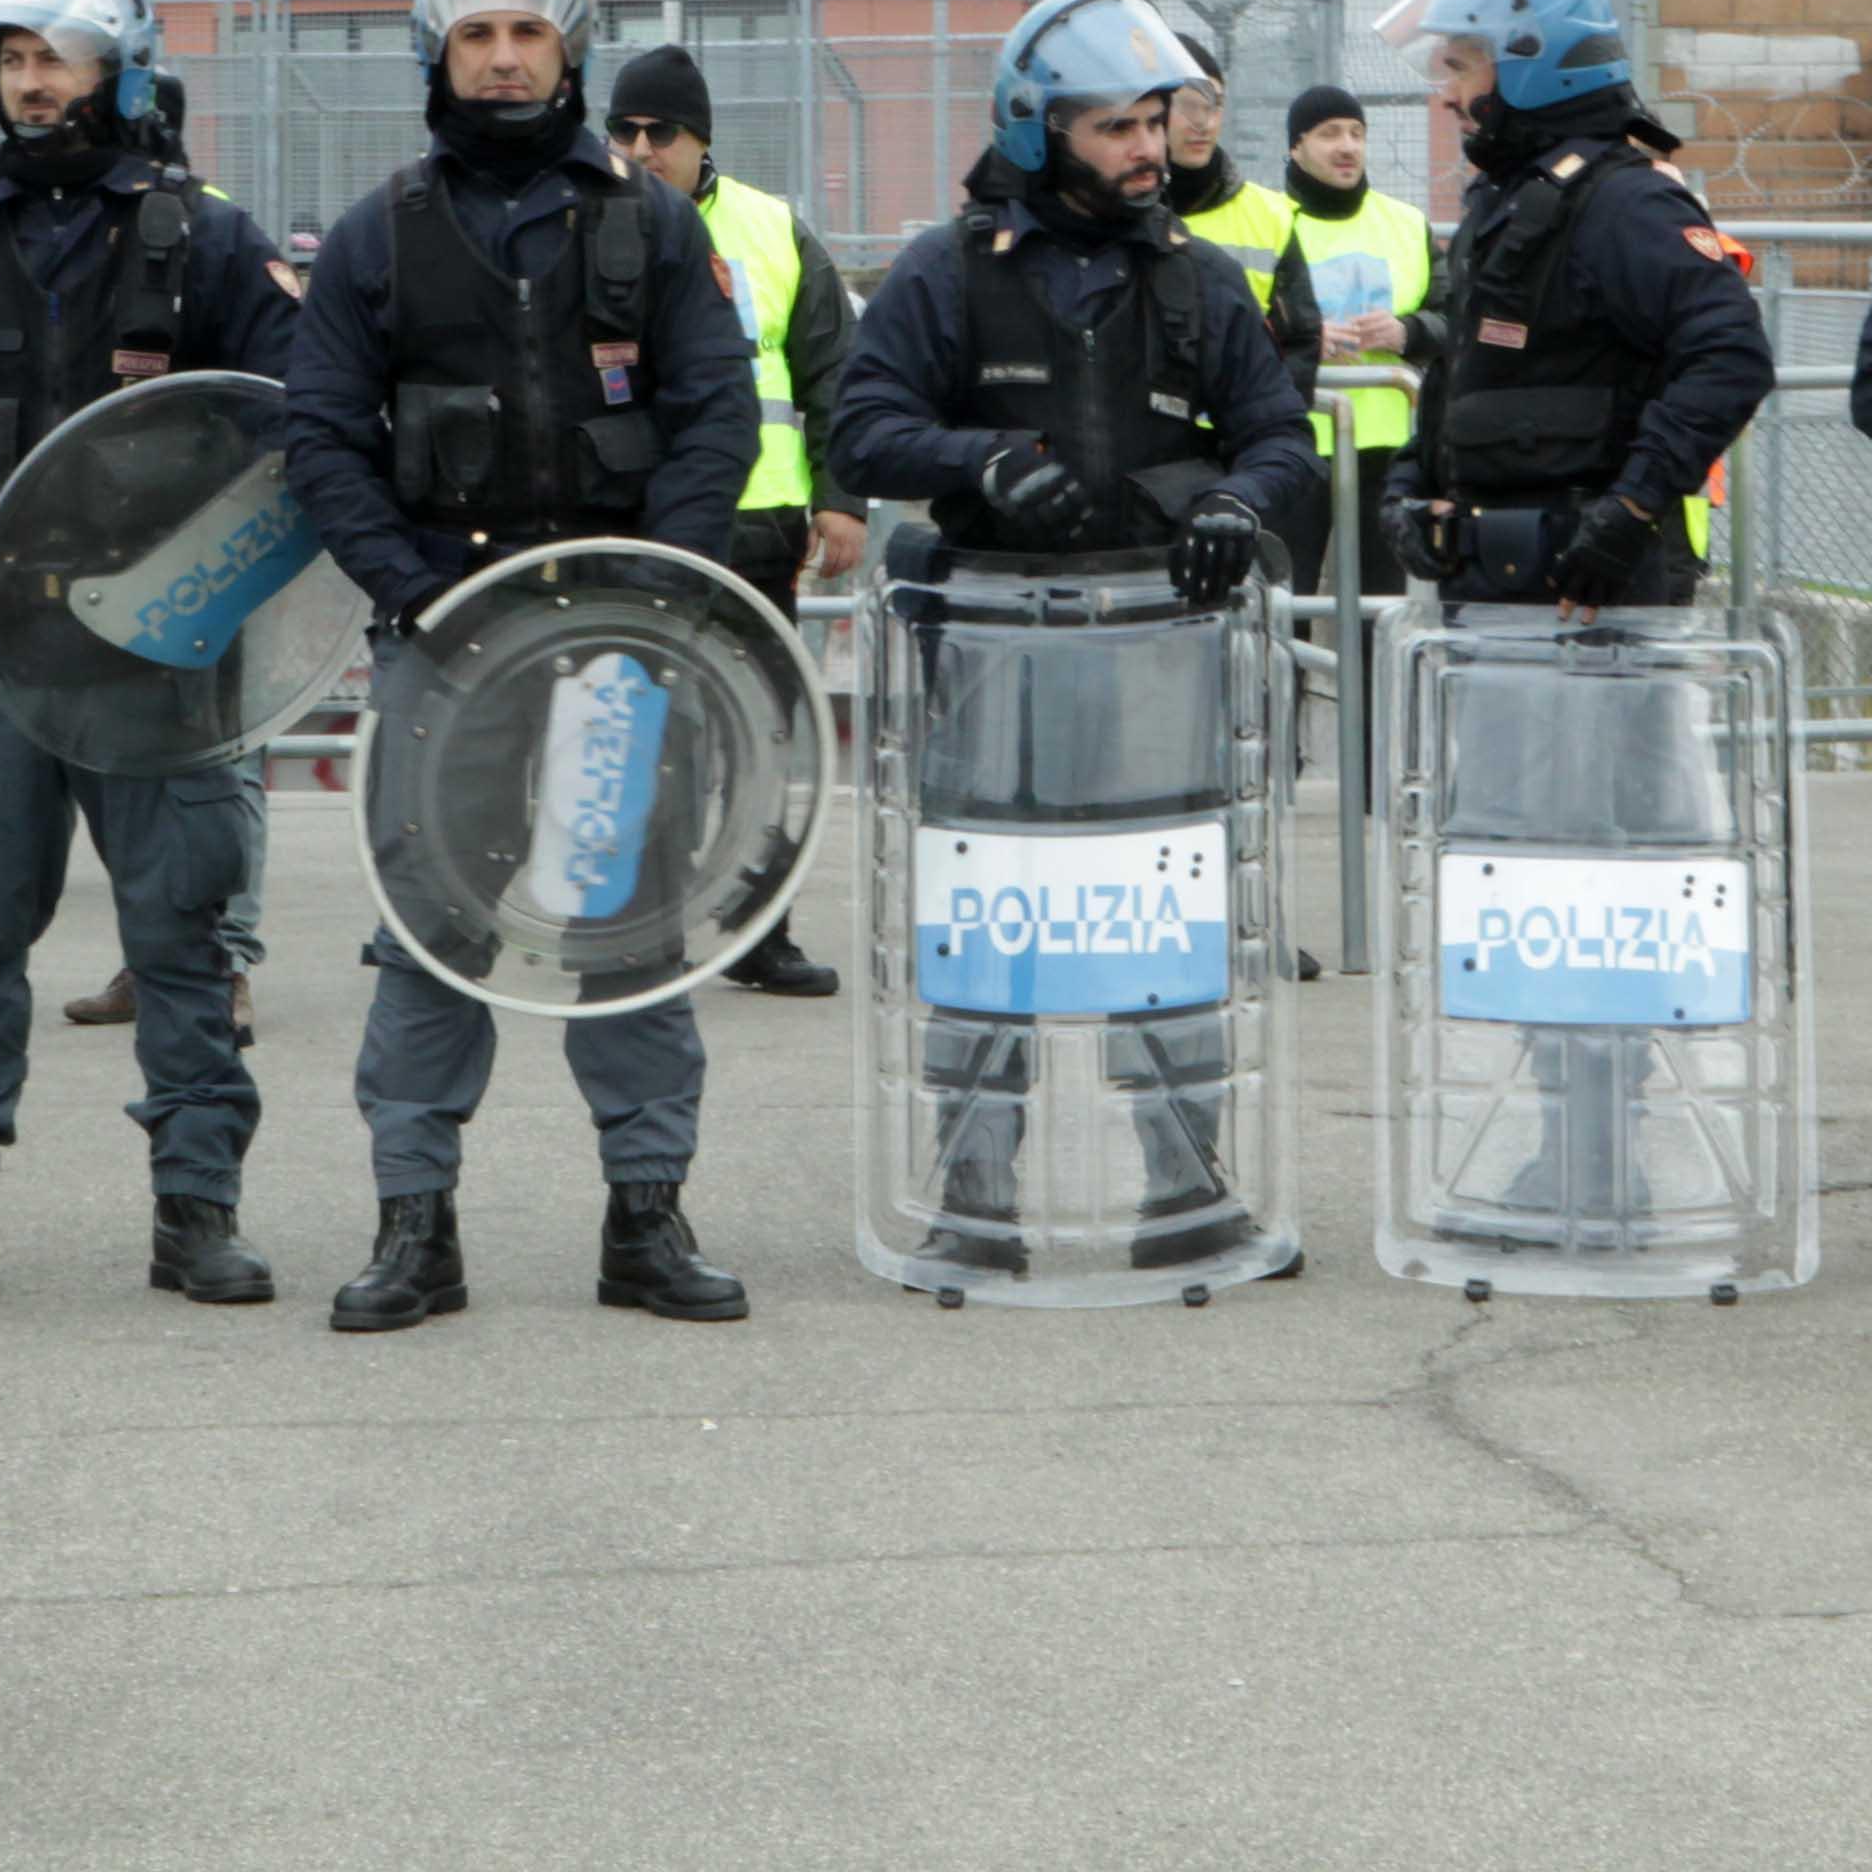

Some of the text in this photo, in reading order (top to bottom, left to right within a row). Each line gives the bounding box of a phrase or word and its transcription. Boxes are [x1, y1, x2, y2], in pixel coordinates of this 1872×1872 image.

[562, 674, 642, 887] POLIZIA
[948, 883, 1193, 957] POLIZIA
[1474, 904, 1718, 979] POLIZIA
